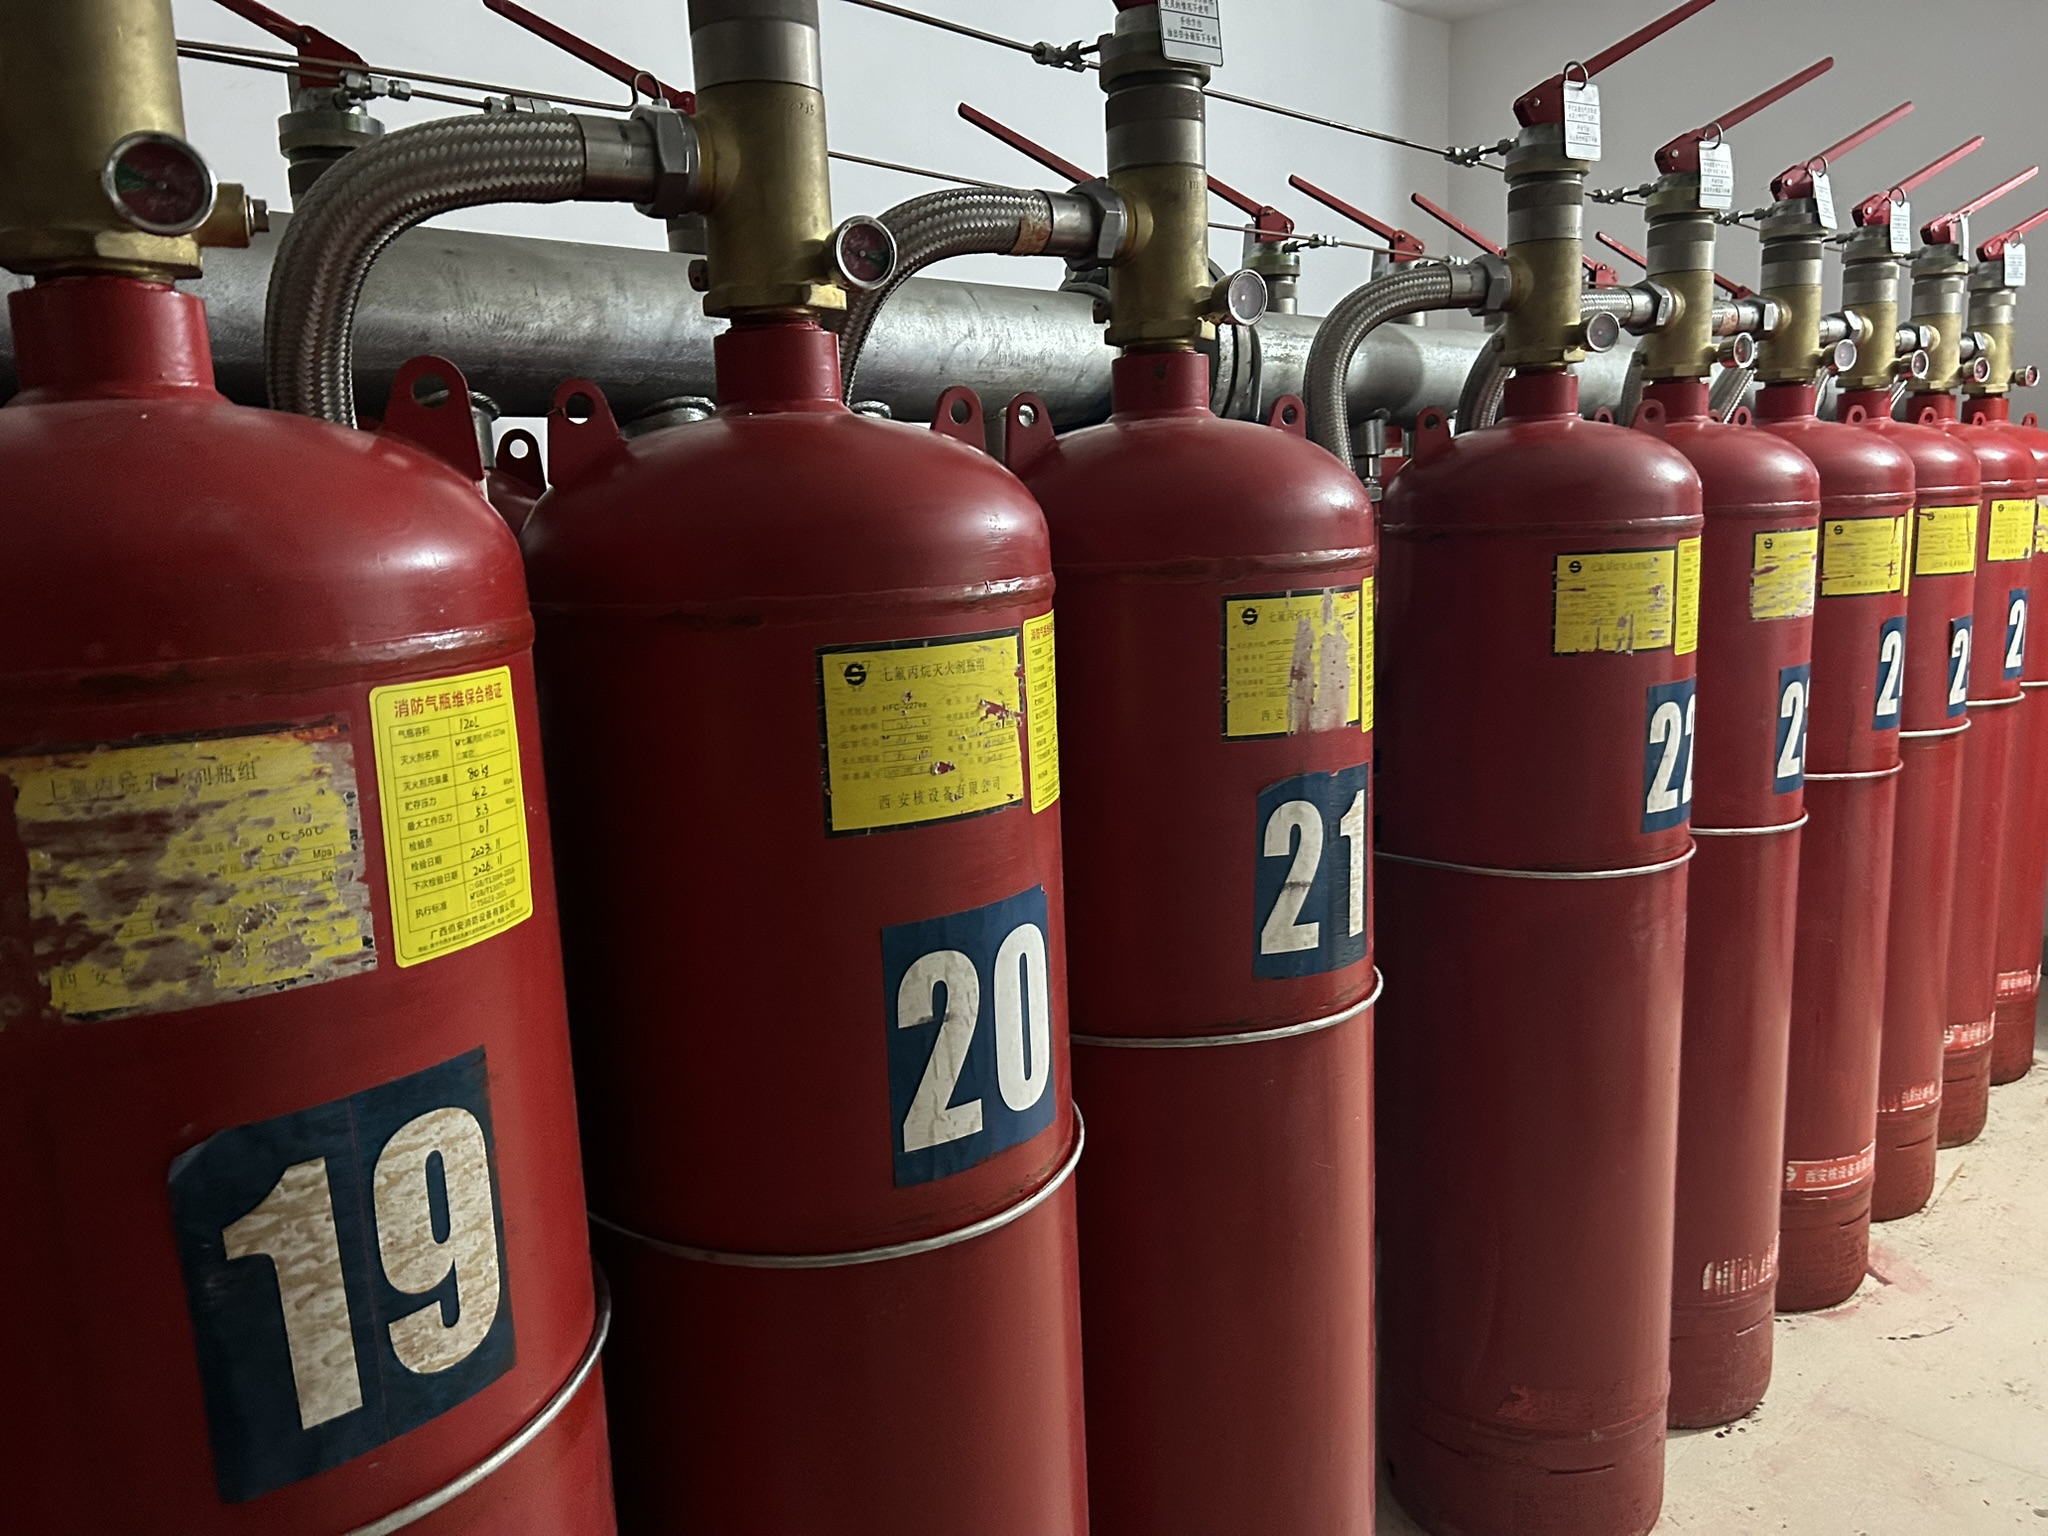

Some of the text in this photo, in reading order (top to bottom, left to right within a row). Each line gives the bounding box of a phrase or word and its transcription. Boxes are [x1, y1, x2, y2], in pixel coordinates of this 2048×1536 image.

[2005, 599, 2028, 668] 2
[1876, 630, 1905, 716] 2
[1949, 625, 1973, 705] 2
[394, 682, 503, 718] 消防气瓶维保合格证
[397, 725, 431, 739] 气瓶容积
[400, 749, 440, 765] 灭火剂名称
[407, 812, 453, 832] 最大工作压力
[409, 837, 433, 852] 检验员
[411, 855, 443, 871] 检验日期
[1260, 789, 1365, 954] 21
[413, 870, 458, 891] 下次检验日期
[415, 901, 447, 919] 执行标准
[897, 923, 1051, 1153] 20
[222, 1106, 501, 1430] 19
